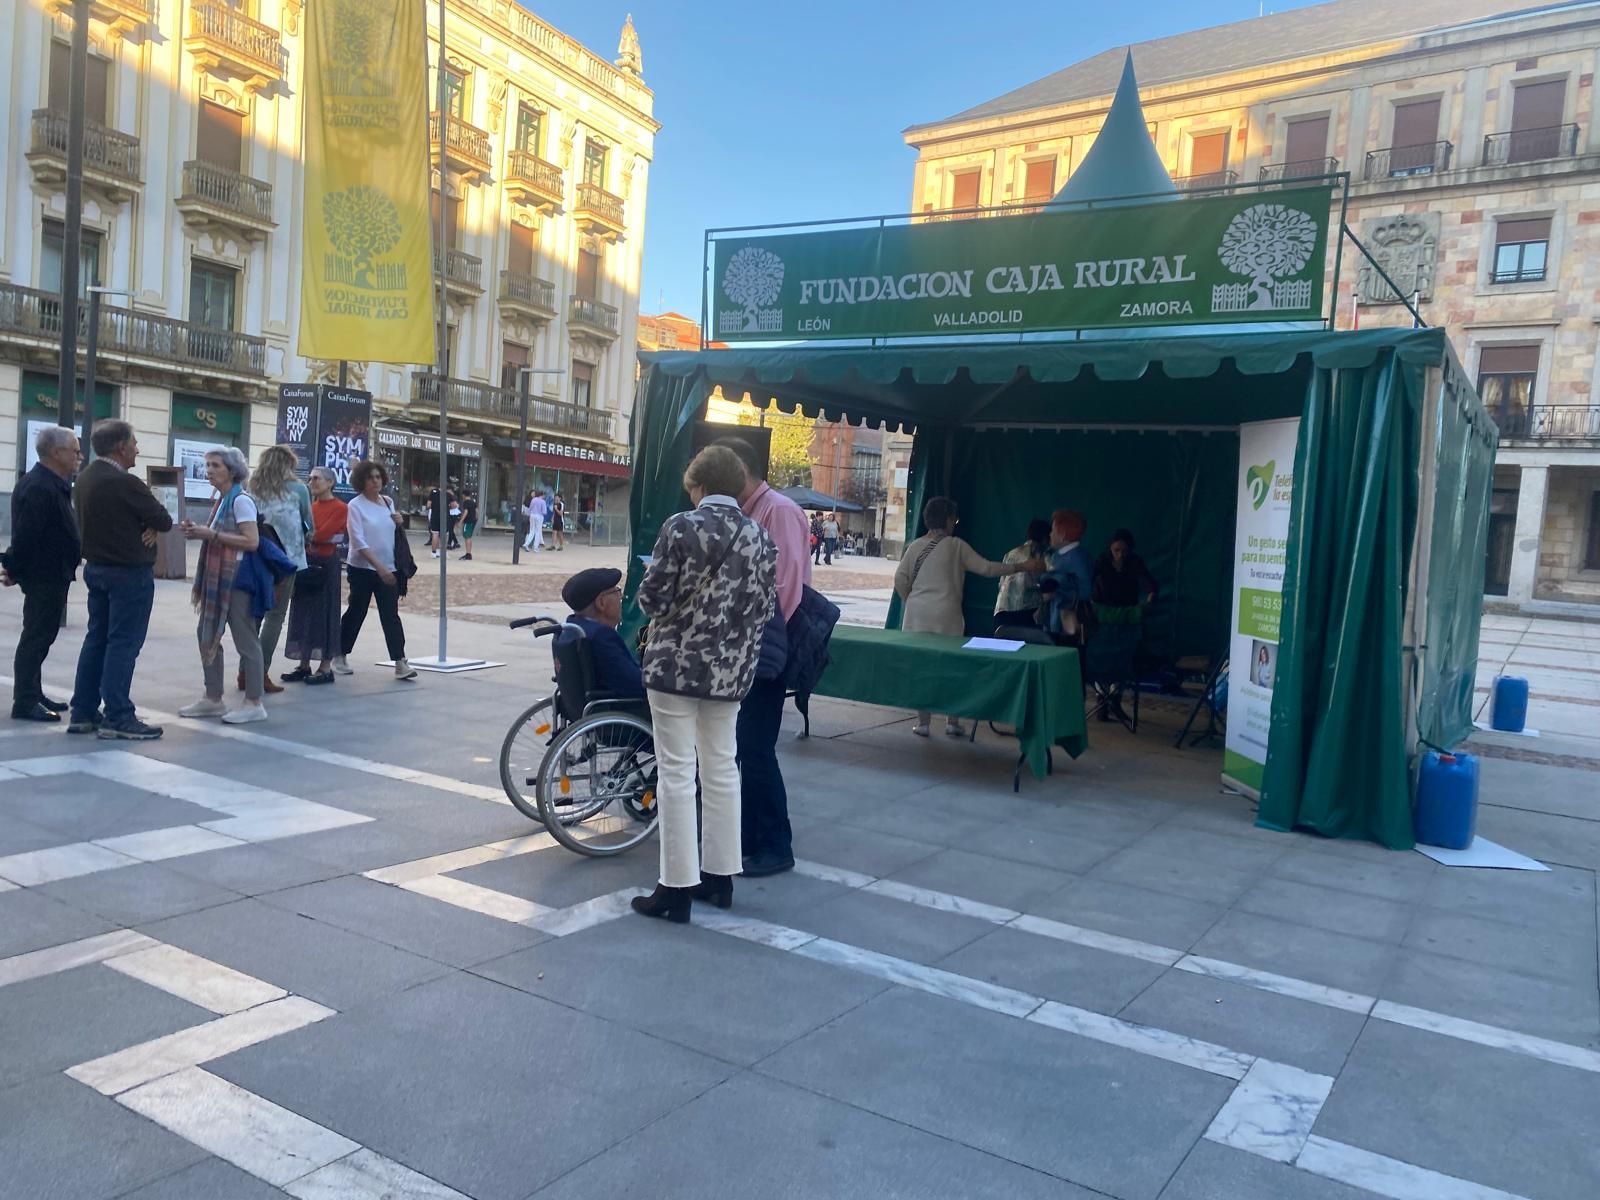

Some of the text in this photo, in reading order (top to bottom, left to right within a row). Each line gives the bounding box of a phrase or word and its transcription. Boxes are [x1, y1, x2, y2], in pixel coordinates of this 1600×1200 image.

[800, 255, 1196, 305] FUNDACION CAJA RURAL
[1119, 300, 1193, 318] ZAMORA
[798, 316, 832, 332] LEÓN
[933, 310, 1024, 327] VALLADOLID
[283, 389, 314, 397] CaixaForum
[327, 391, 366, 405] CaixaForum
[286, 406, 308, 419] SYM
[286, 418, 308, 430] PHO
[289, 429, 304, 442] NY
[378, 432, 407, 446] CALZADOS
[411, 437, 422, 448] LOS
[425, 439, 455, 453] VALENNES
[325, 435, 362, 455] SYM
[325, 452, 360, 469] PH
[1248, 535, 1258, 548] Un
[1241, 552, 1257, 564] para
